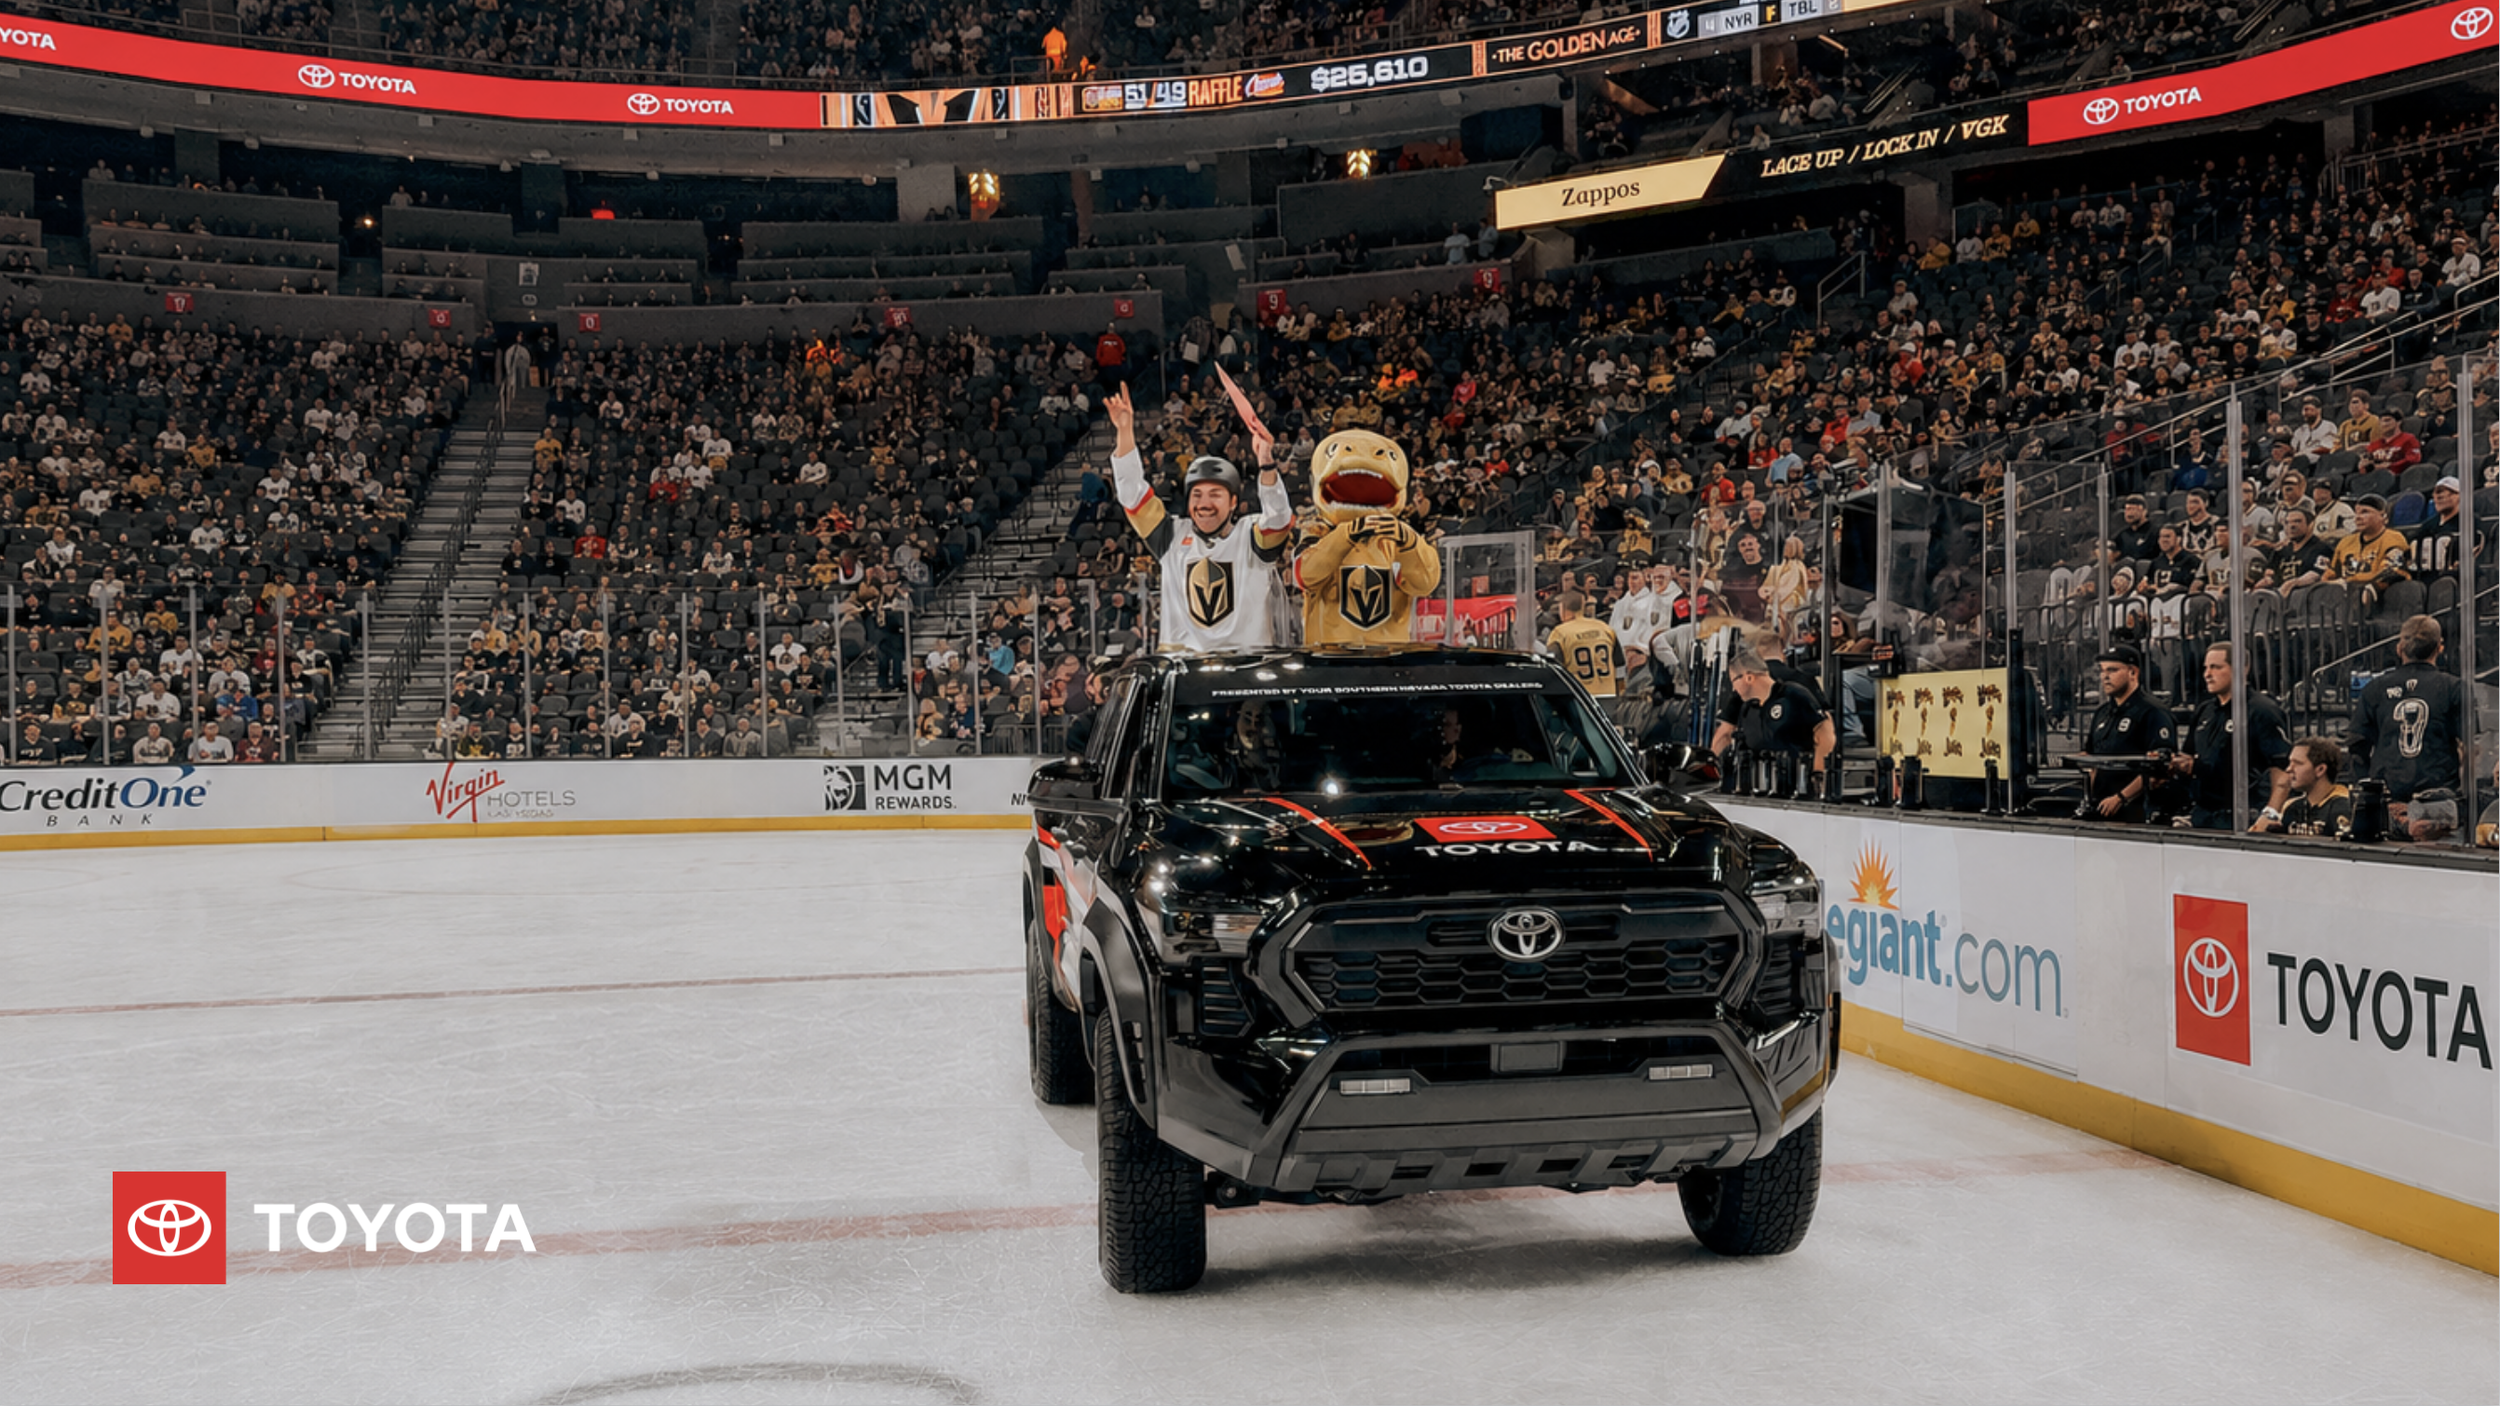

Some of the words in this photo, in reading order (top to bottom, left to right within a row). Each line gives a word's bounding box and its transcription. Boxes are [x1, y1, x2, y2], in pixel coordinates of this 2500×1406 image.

[1725, 12, 1753, 30] NYR
[1789, 0, 1818, 17] TBL
[0, 26, 57, 51] YOTA
[1496, 46, 1525, 63] THE
[1527, 29, 1606, 62] GOLDEN
[1607, 26, 1636, 47] AGE
[338, 71, 417, 95] TOYOTA
[1310, 55, 1429, 93] $25,610
[1188, 75, 1243, 107] RAFFLE
[2123, 86, 2203, 115] TOYOTA
[663, 98, 735, 115] TOYOTA
[1760, 152, 1812, 178] LACE
[1815, 147, 1845, 169] UP
[1862, 137, 1911, 161] LOCK
[1915, 128, 1941, 149] IN
[1960, 114, 2011, 140] VGK
[1561, 181, 1641, 208] Zappos
[1574, 644, 1610, 680] 93
[1300, 687, 1332, 695] YOUR
[1448, 683, 1493, 691] TOYOTA
[873, 763, 952, 791] MGM
[425, 761, 506, 823] Virgin
[487, 789, 577, 807] HOTELS
[1413, 840, 1608, 858] TOYOTA
[2266, 951, 2494, 1071] TOYOTA
